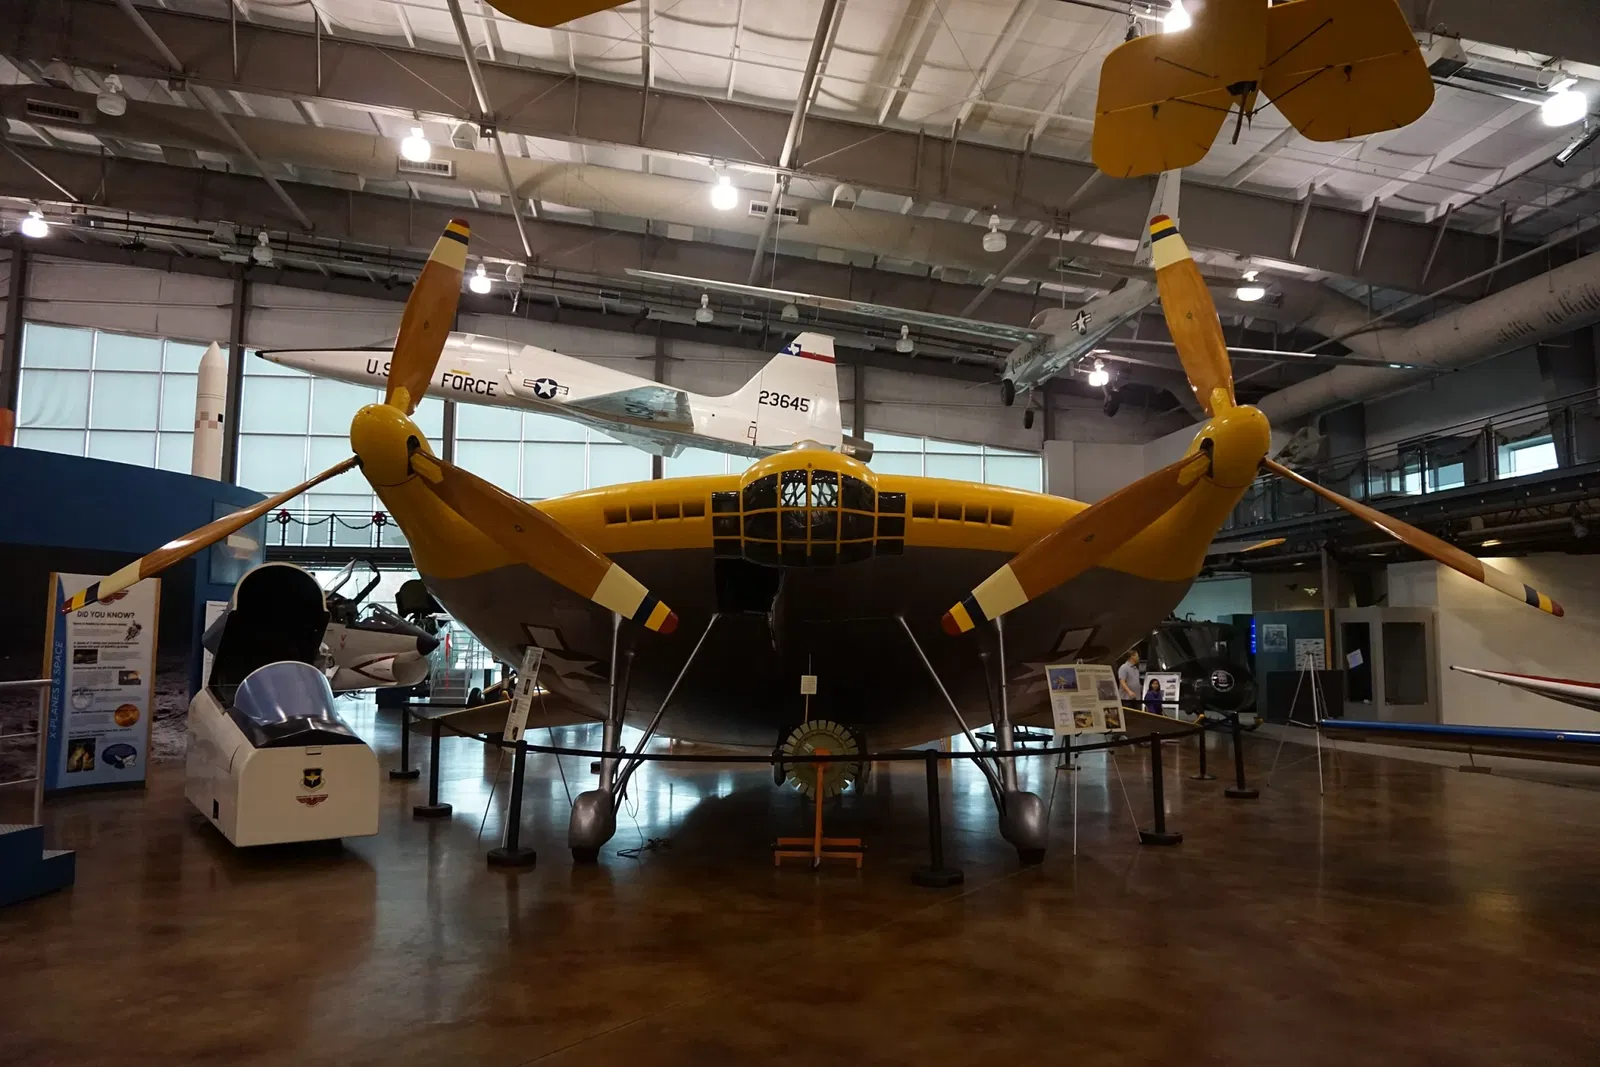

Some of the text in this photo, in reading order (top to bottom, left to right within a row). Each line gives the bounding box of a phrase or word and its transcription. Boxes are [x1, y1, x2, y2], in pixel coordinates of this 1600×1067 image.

[441, 373, 498, 397] FORCE
[759, 390, 810, 412] 23645
[53, 641, 63, 675] SPACE
[50, 687, 60, 738] X-PLANES
